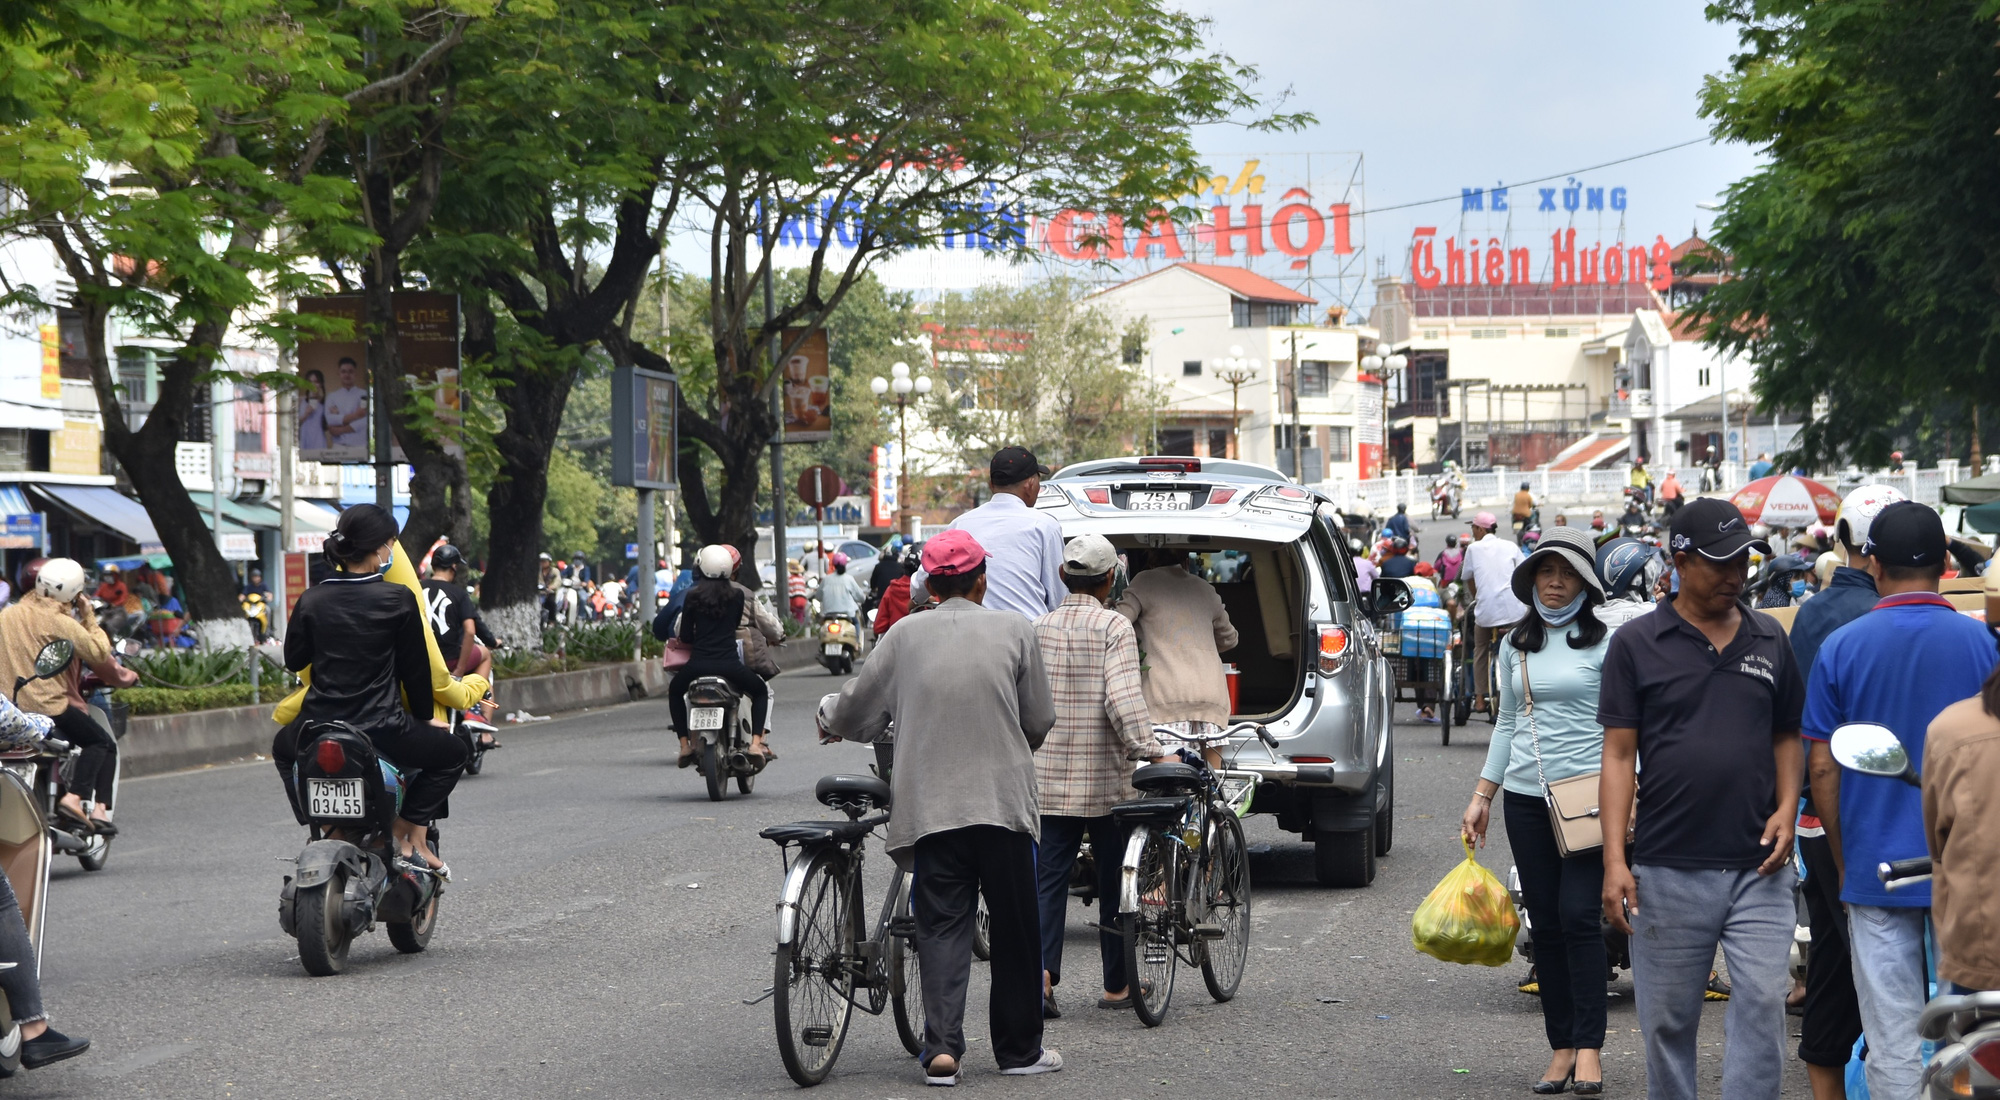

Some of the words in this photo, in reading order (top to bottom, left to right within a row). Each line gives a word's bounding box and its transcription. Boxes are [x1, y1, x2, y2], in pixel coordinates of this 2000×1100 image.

[1046, 206, 1186, 260] GIA
[1211, 186, 1356, 270] HỘI
[1411, 226, 1531, 290] Thiên
[1550, 226, 1674, 292] Hương
[1144, 492, 1176, 502] 75A
[1243, 507, 1272, 516] TRD
[1769, 503, 1809, 511] VEDAN
[694, 718, 718, 728] 2686
[313, 798, 361, 815] 034.55
